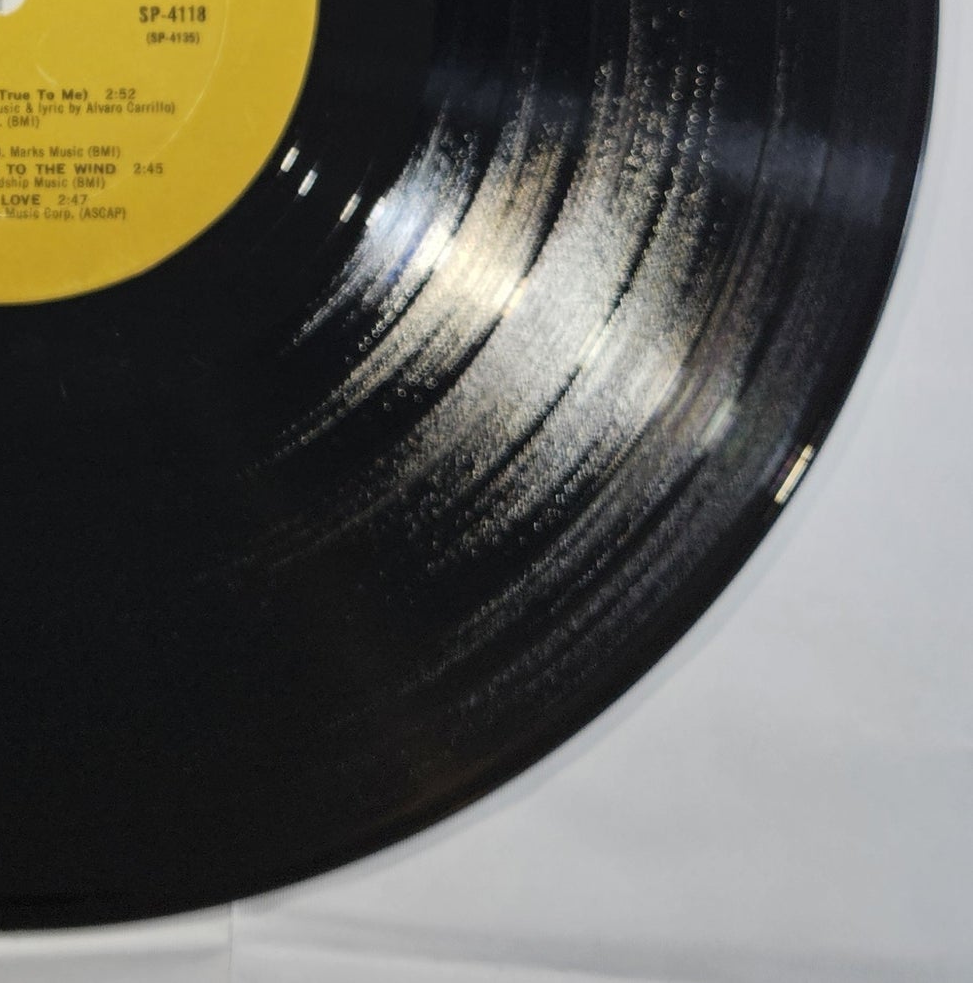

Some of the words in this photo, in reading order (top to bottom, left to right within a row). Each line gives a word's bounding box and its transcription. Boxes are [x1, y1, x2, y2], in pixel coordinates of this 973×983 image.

[139, 5, 206, 23] SP-4118
[146, 32, 200, 44] (SP-4135)
[0, 88, 30, 101] True
[37, 88, 55, 101] To
[62, 88, 88, 101] Me)
[105, 88, 136, 100] 2:52
[26, 102, 33, 115] &
[39, 102, 63, 114] lyric
[70, 102, 81, 114] by
[86, 102, 122, 114] Alvaro
[127, 101, 175, 114] Carrillo)
[8, 116, 39, 128] (BMI)
[11, 146, 44, 159] Marks
[49, 146, 83, 158] Music
[88, 145, 120, 158] (BMI)
[7, 163, 26, 175] TO
[35, 163, 66, 175] THE
[74, 162, 116, 175] WIND
[133, 162, 163, 174] 2:45
[35, 177, 67, 188] Music
[72, 176, 105, 188] (BMI)
[1, 194, 40, 206] LOVE
[58, 193, 88, 205] 2:47
[5, 207, 39, 219] Music
[44, 207, 74, 219] Corp.
[79, 207, 126, 219] (ASCAP)
